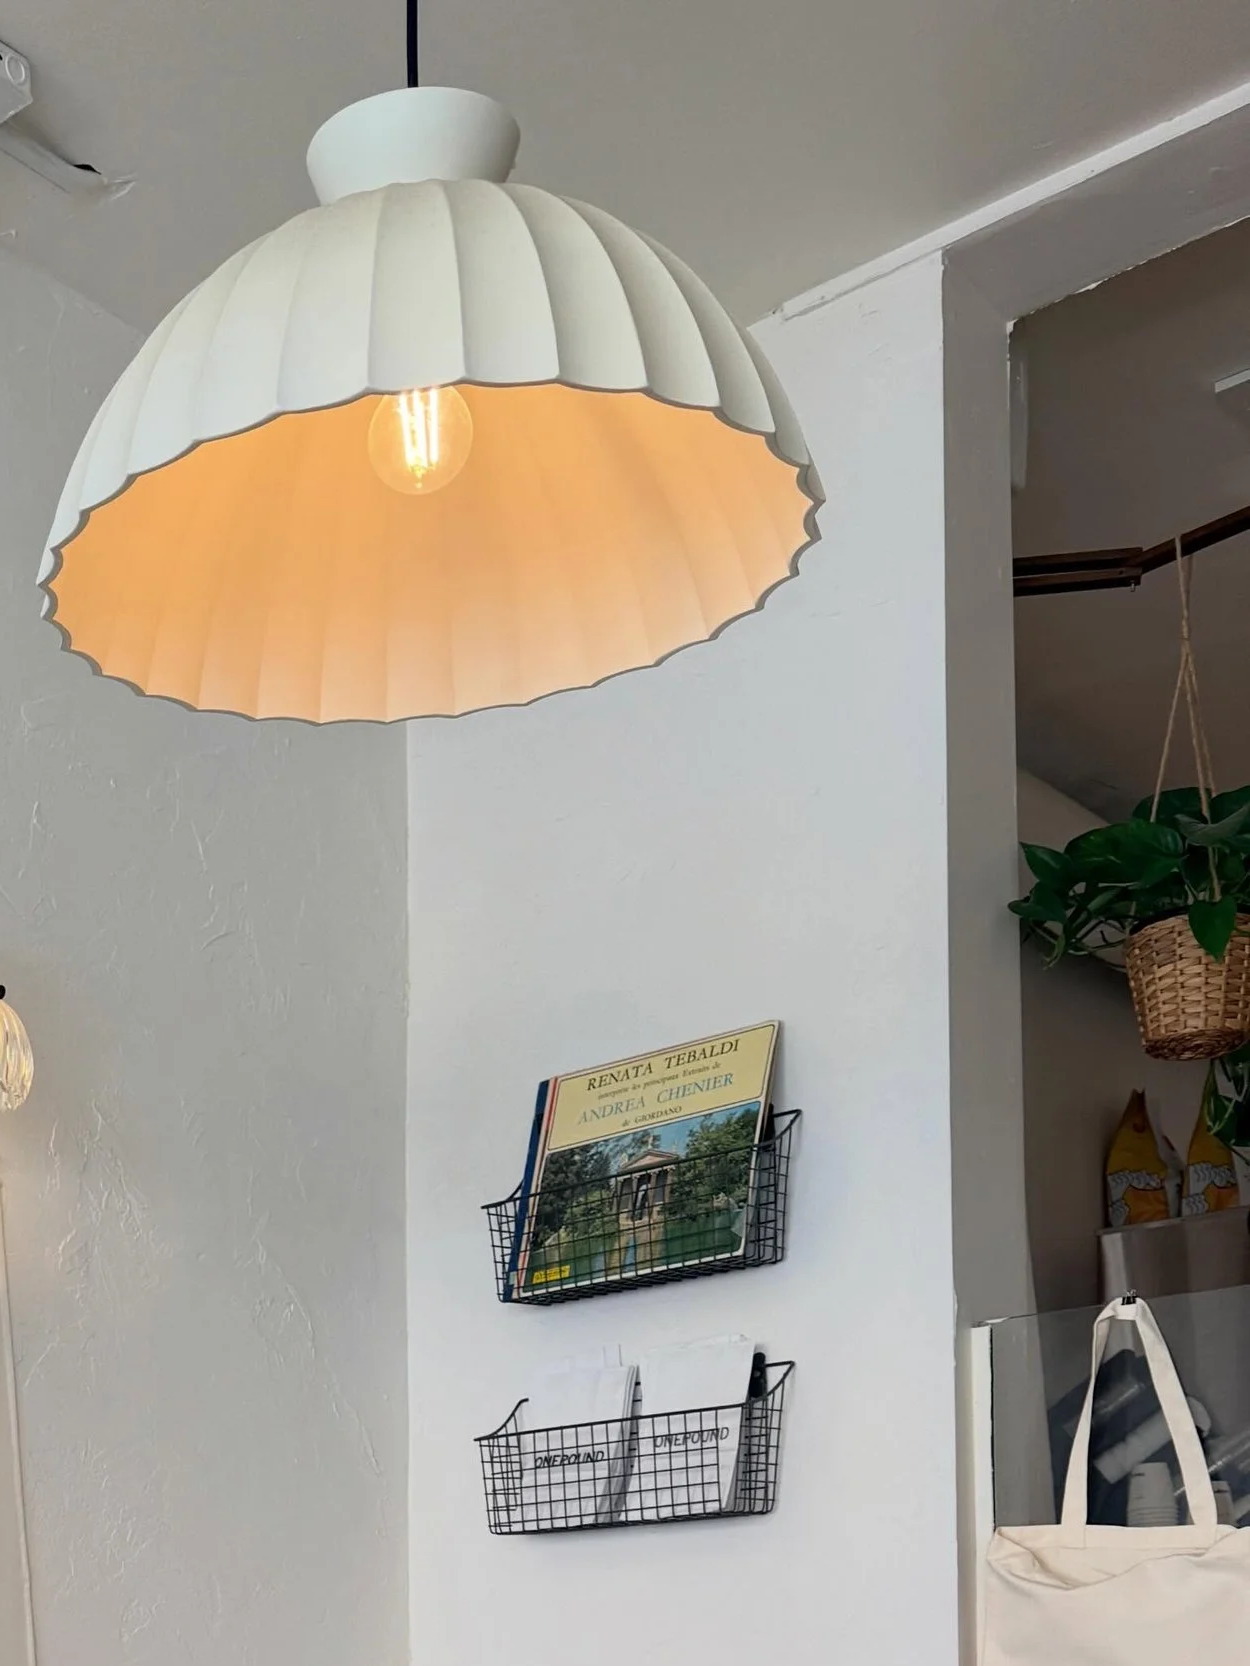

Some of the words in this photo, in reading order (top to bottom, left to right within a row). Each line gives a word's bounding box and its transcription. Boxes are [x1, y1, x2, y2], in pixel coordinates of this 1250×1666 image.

[587, 1062, 653, 1091] RENATA
[664, 1039, 741, 1069] TEBALDI
[577, 1096, 646, 1125] ANDREA
[656, 1072, 734, 1104] CHENIER
[634, 1106, 682, 1123] GIORDANO
[654, 1426, 730, 1449] ONEPOUND
[535, 1450, 605, 1468] ONEPOUND
